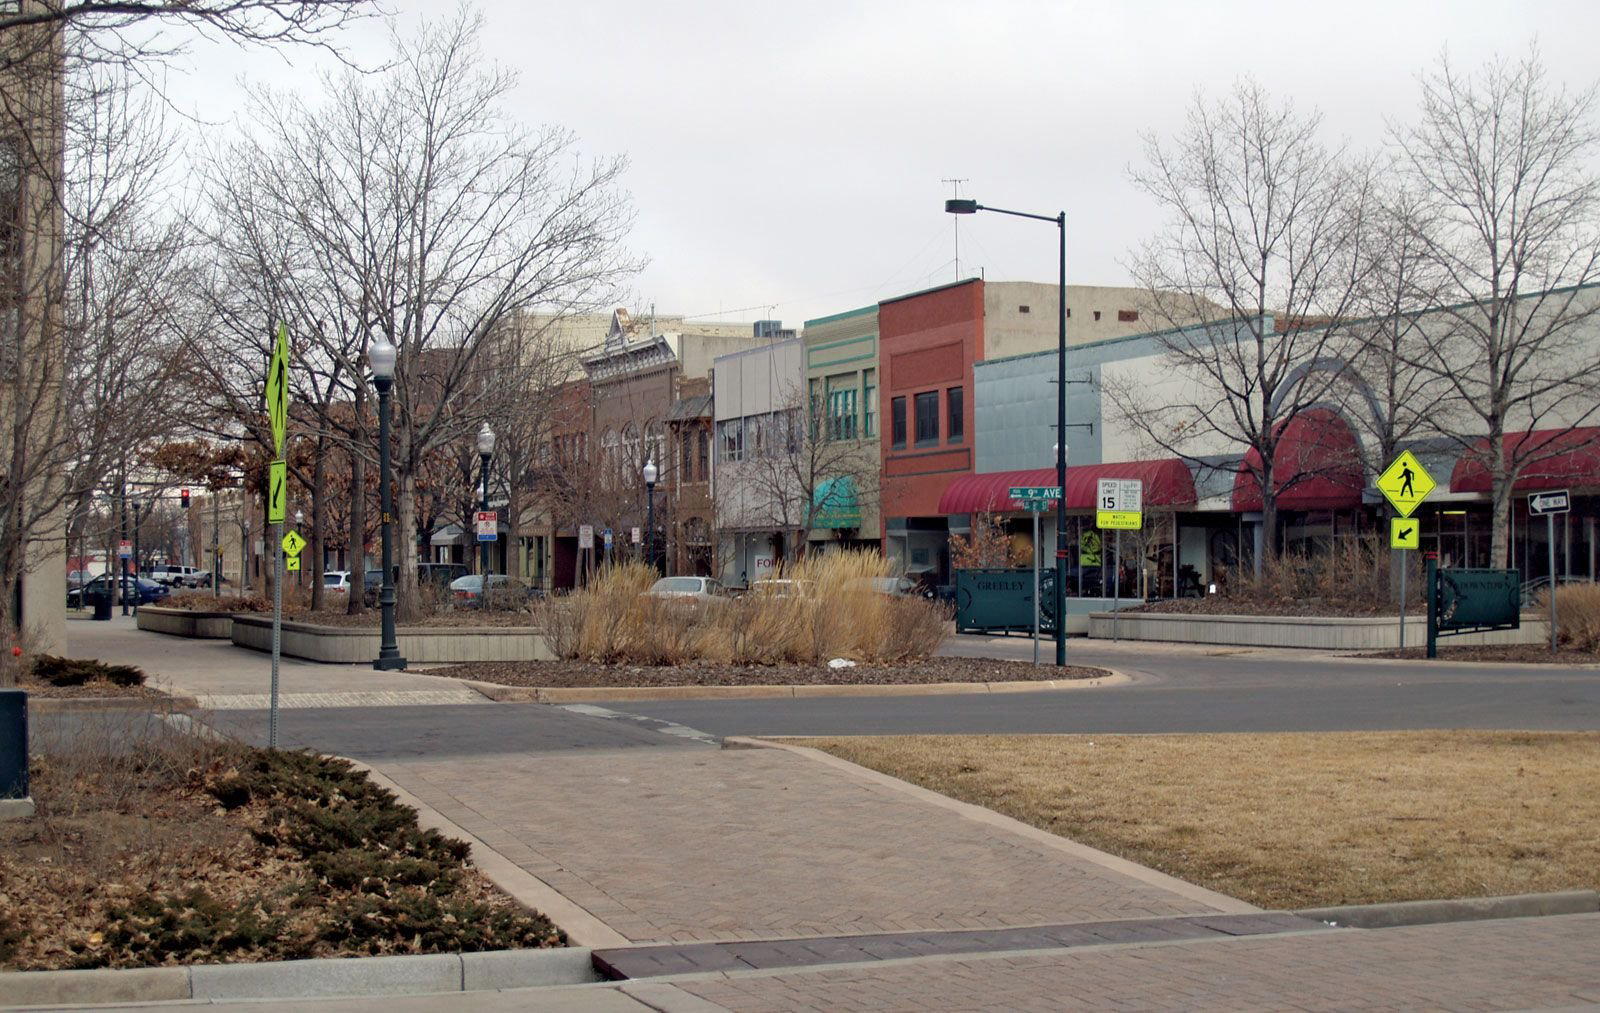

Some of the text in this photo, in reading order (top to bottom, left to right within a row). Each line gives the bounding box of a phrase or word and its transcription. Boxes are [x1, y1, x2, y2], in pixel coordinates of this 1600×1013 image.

[1043, 488, 1061, 498] AVE
[1102, 497, 1115, 508] 15
[977, 581, 1025, 591] GREELEY
